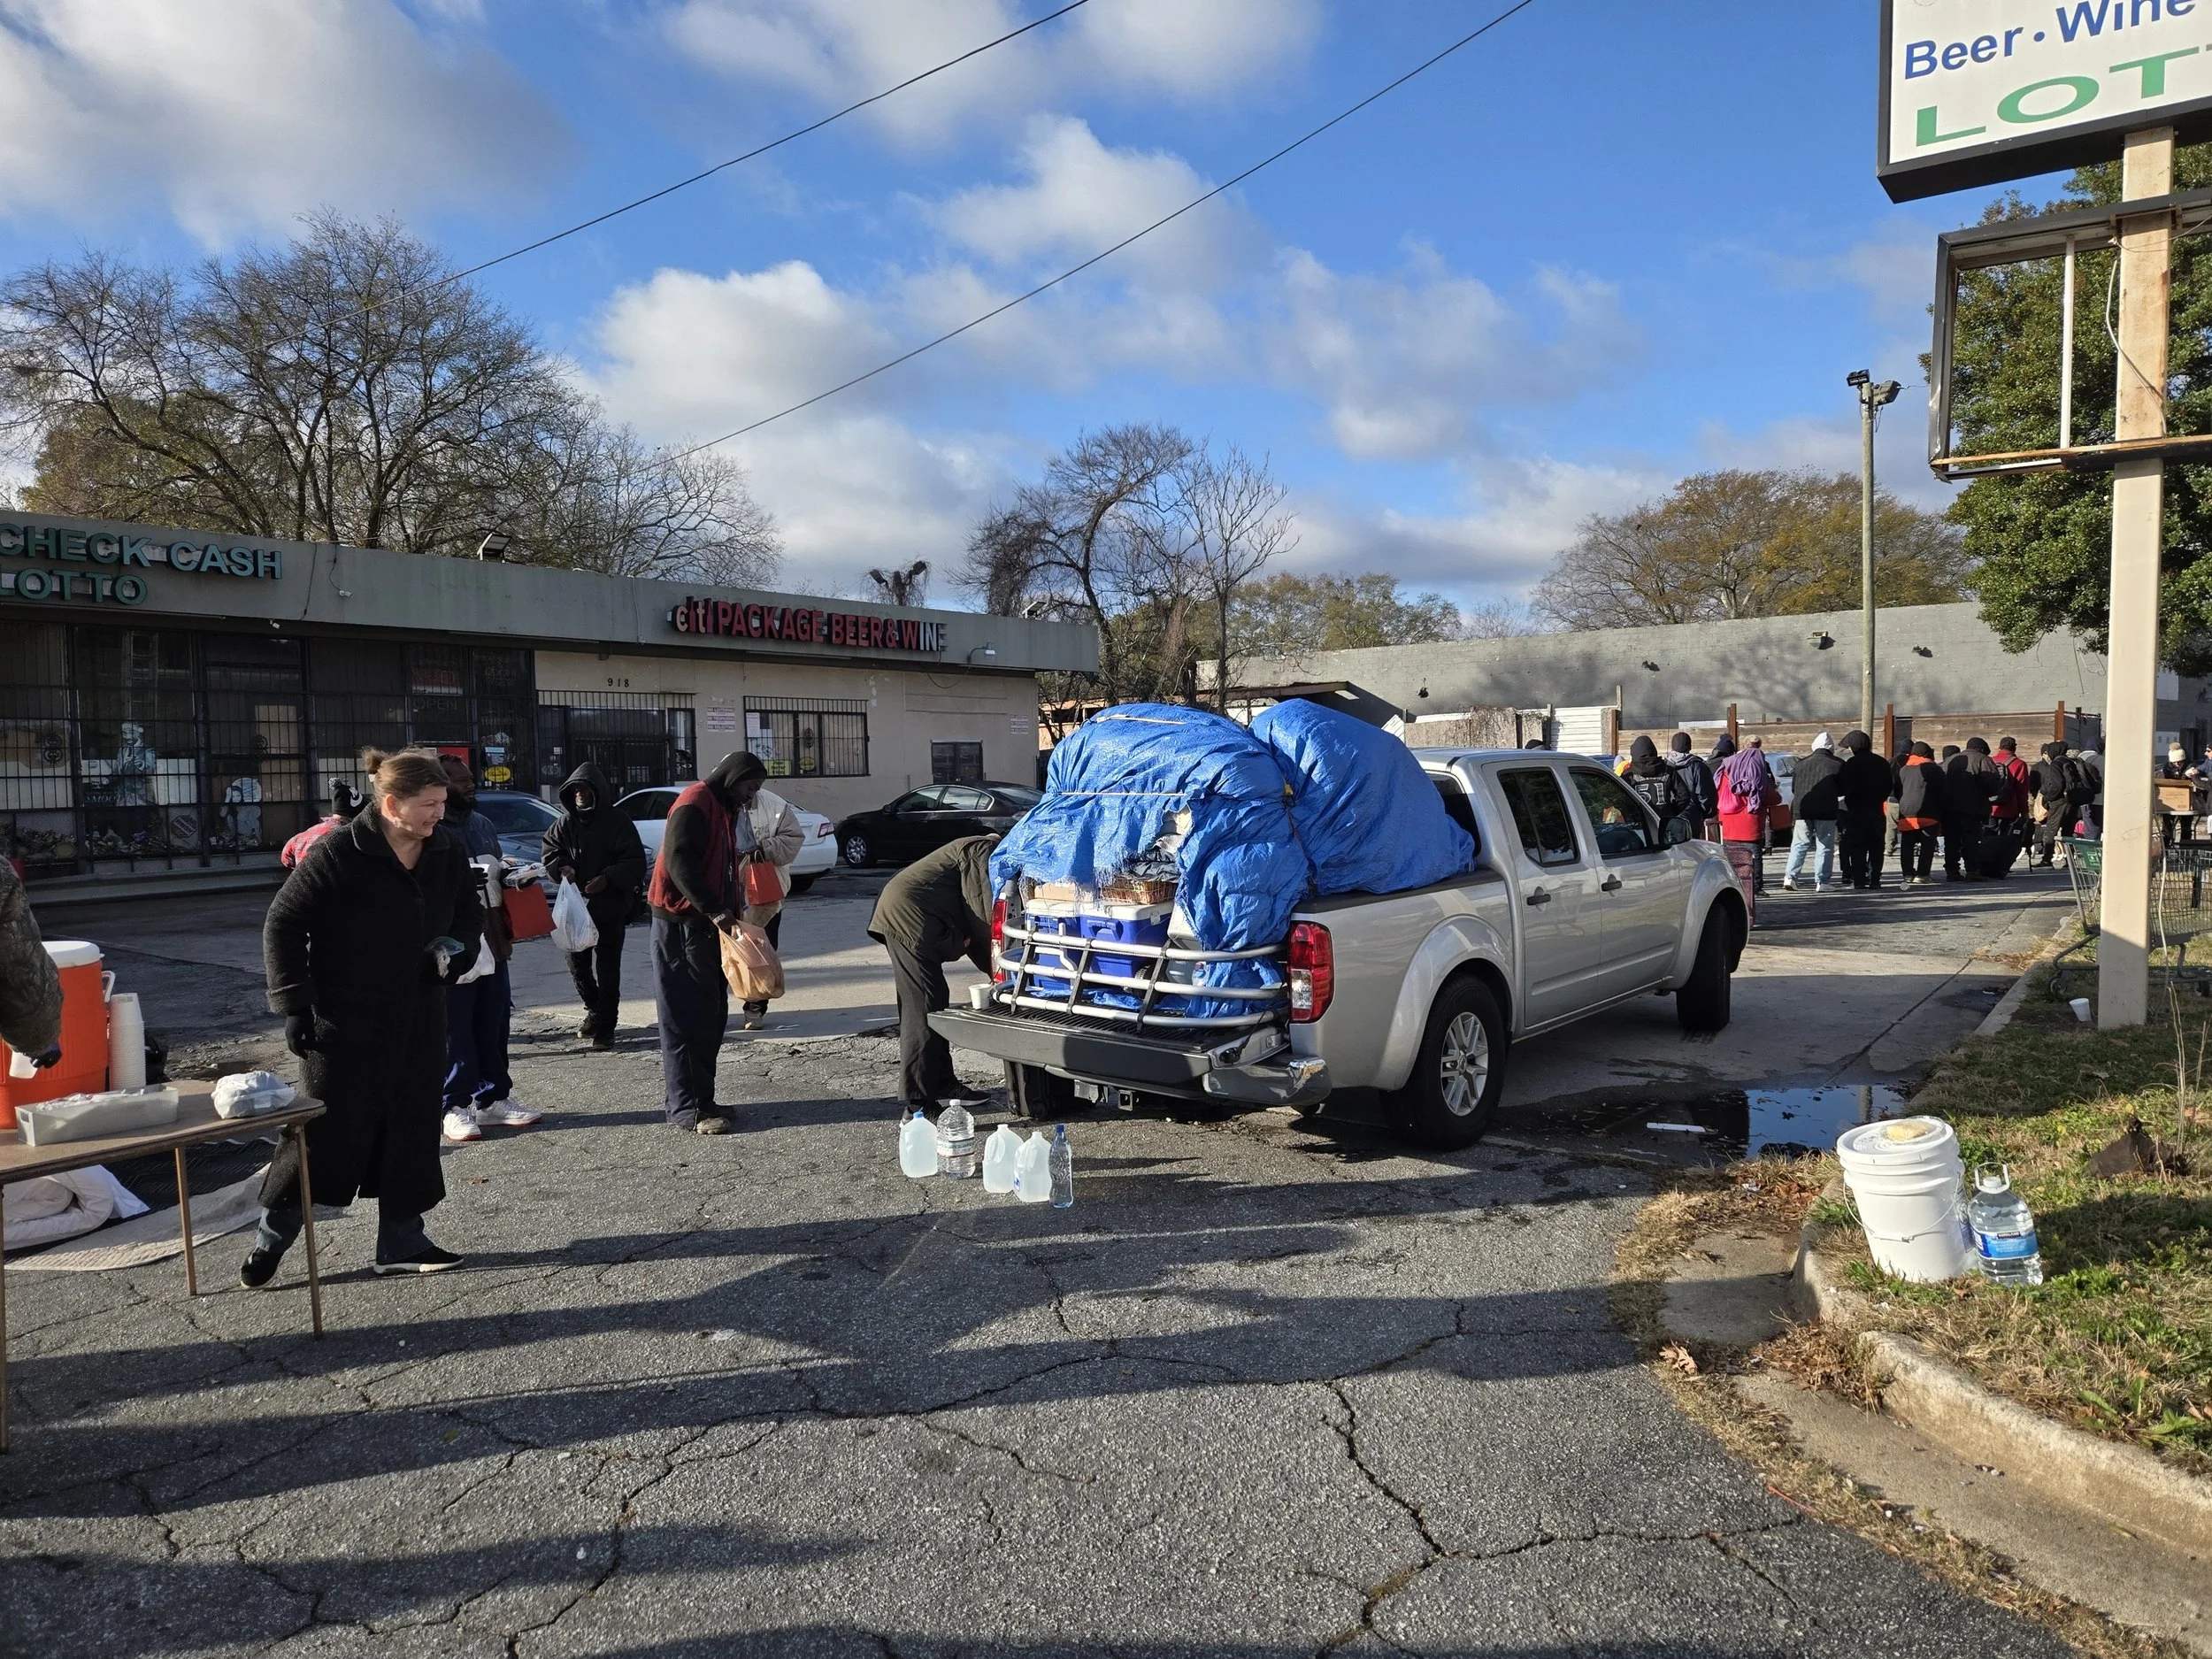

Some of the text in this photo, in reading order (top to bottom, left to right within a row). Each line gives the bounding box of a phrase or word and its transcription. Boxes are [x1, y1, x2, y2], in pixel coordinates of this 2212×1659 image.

[1905, 27, 2024, 80] Beer
[1916, 44, 2212, 147] LOT
[0, 523, 282, 580] CHECK CASH
[713, 601, 825, 643] PACKAGE
[1635, 783, 1666, 805] 51
